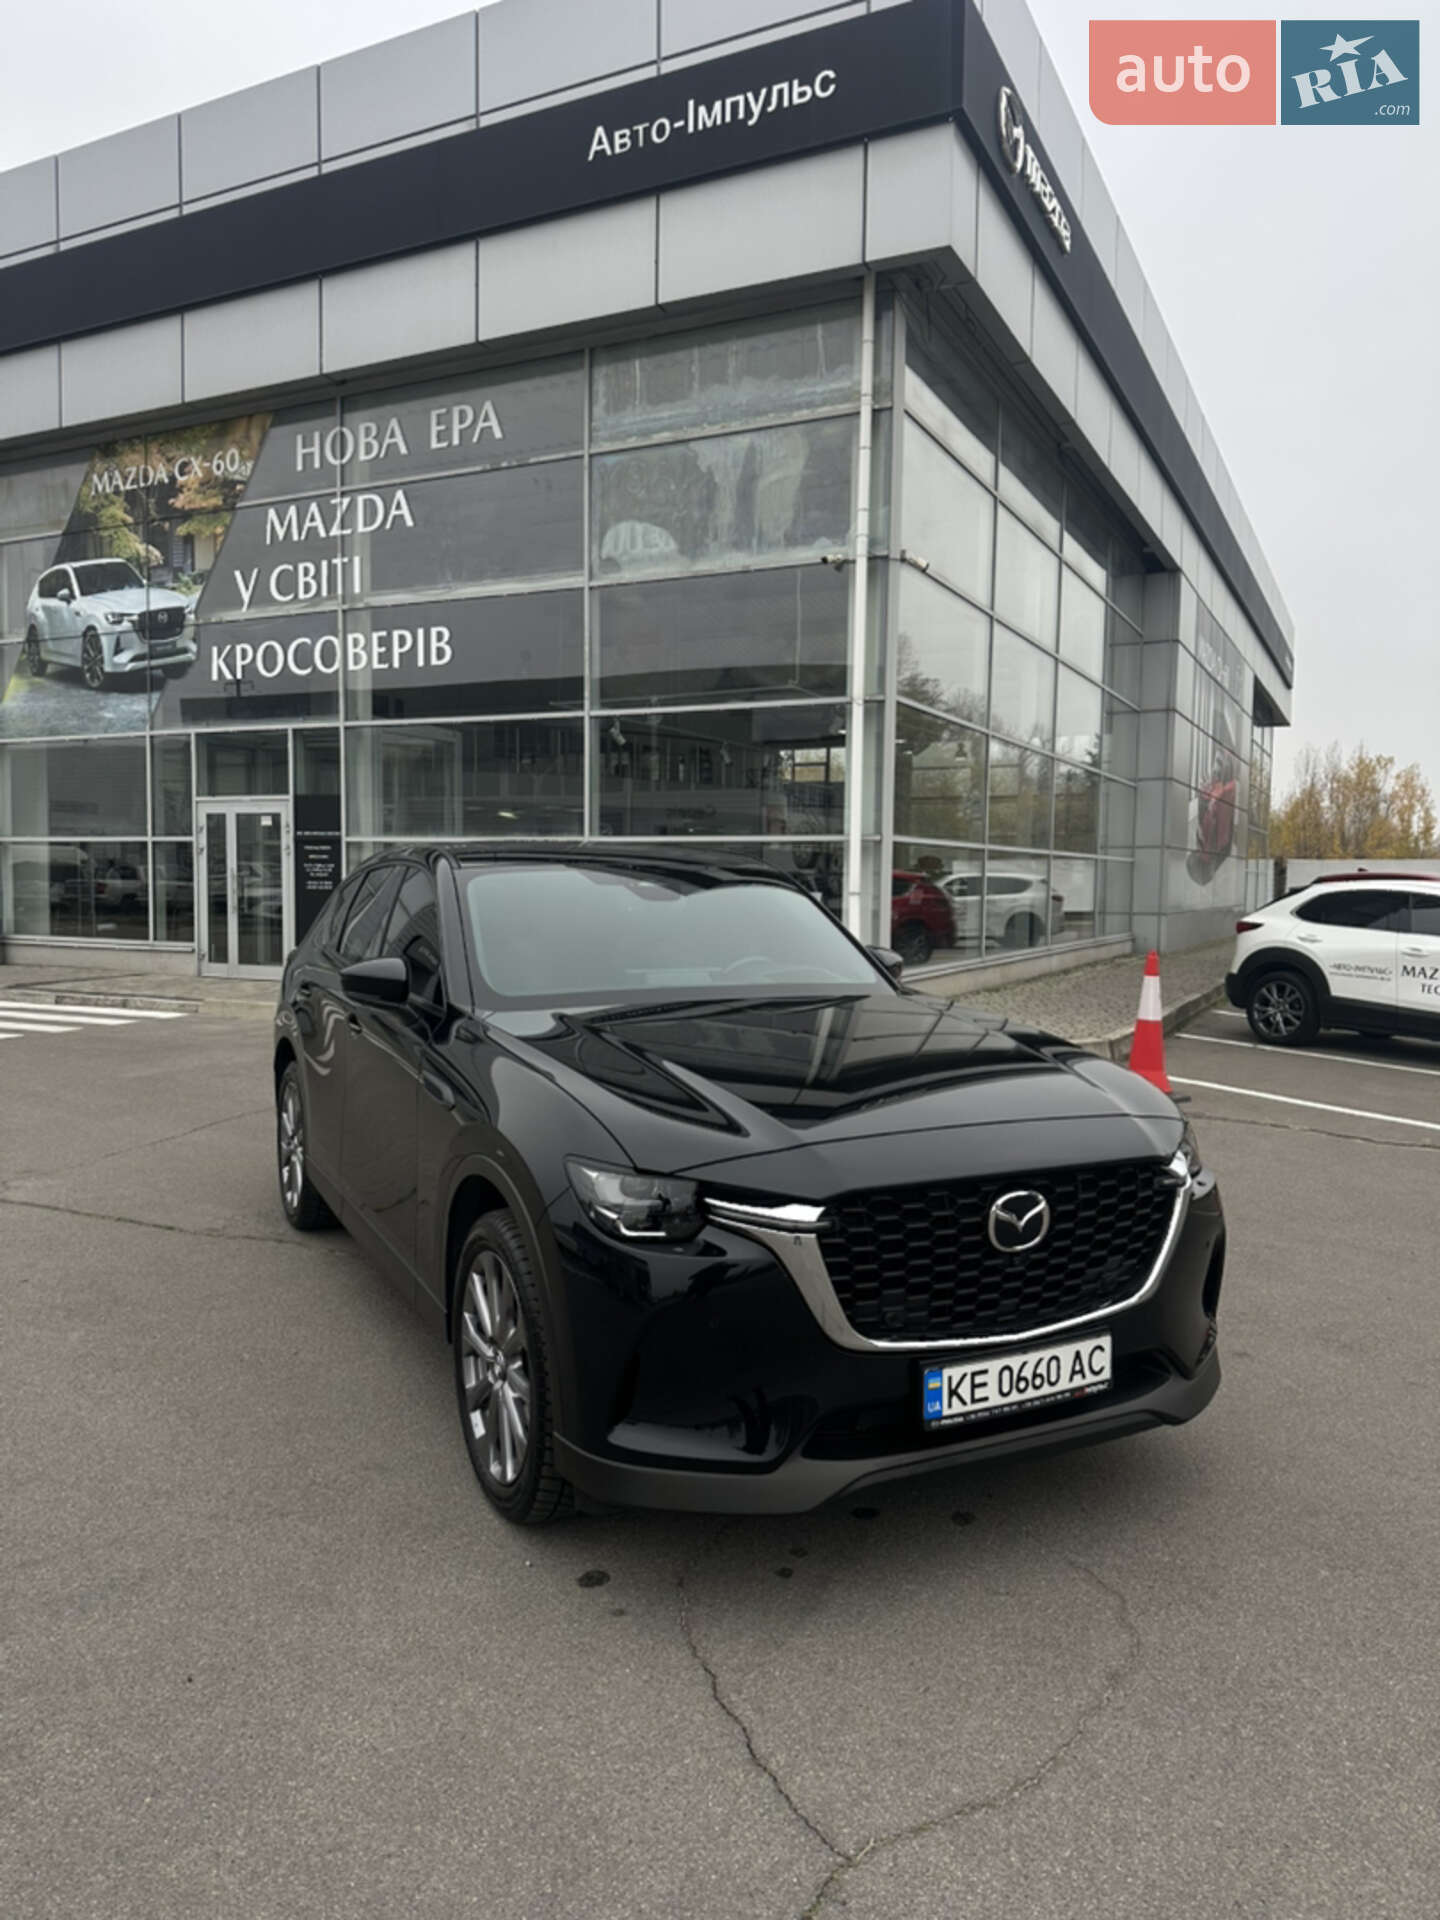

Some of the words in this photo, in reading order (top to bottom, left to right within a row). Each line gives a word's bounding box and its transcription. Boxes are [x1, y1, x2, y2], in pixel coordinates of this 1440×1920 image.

[588, 69, 836, 161] Авто-Імпульс
[296, 417, 408, 472] НОВА
[430, 400, 502, 450] ЕРА
[91, 463, 169, 497] MAZDA
[174, 448, 239, 481] CX-60
[265, 490, 414, 545] MAZDA
[270, 556, 362, 602] СВІТІ
[210, 626, 453, 682] КРОСОВЕРІВ
[947, 1369, 989, 1409] KE
[998, 1355, 1061, 1398] 0660
[1068, 1345, 1105, 1382] AC
